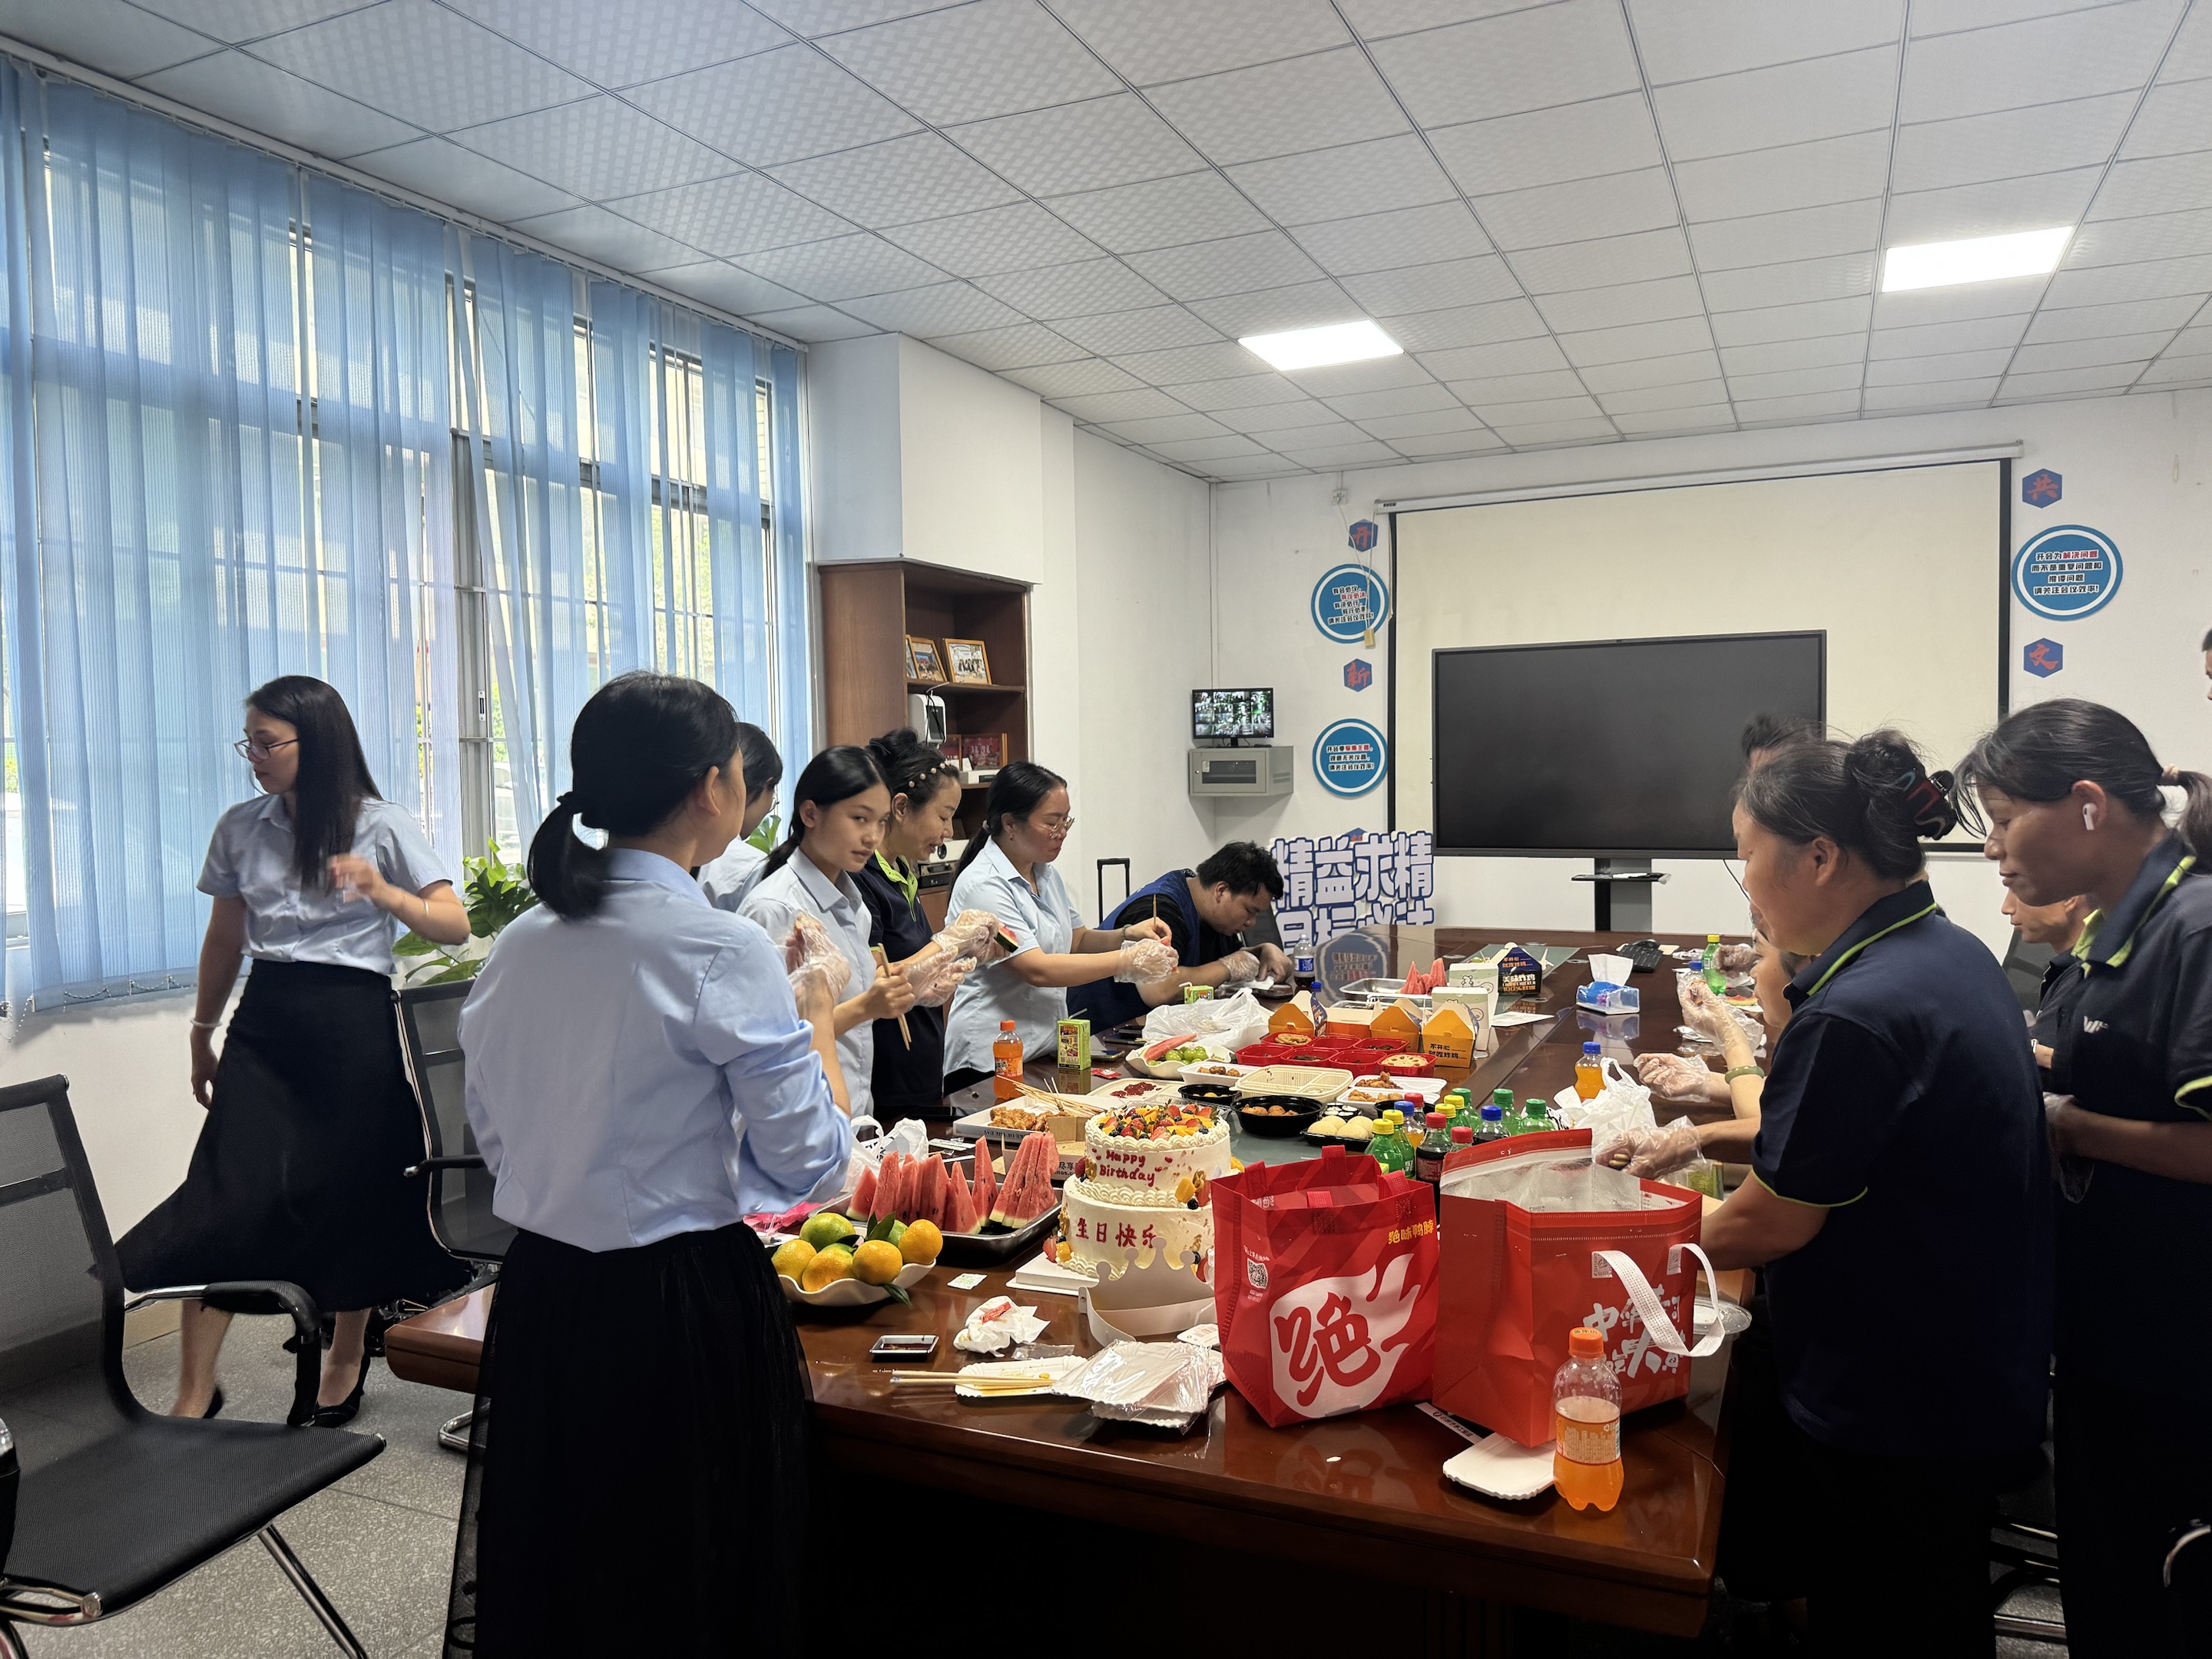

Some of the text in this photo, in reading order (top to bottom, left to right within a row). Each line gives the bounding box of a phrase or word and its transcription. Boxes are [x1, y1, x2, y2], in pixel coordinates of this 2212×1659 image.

[2036, 550, 2098, 561] 开会为解决问题
[1270, 831, 1434, 912] 精益求精
[1105, 1150, 1147, 1167] Happy
[1099, 1164, 1155, 1187] Birthday
[1075, 1217, 1158, 1249] 生日快乐
[1388, 1219, 1434, 1244] 绝味鸭脖
